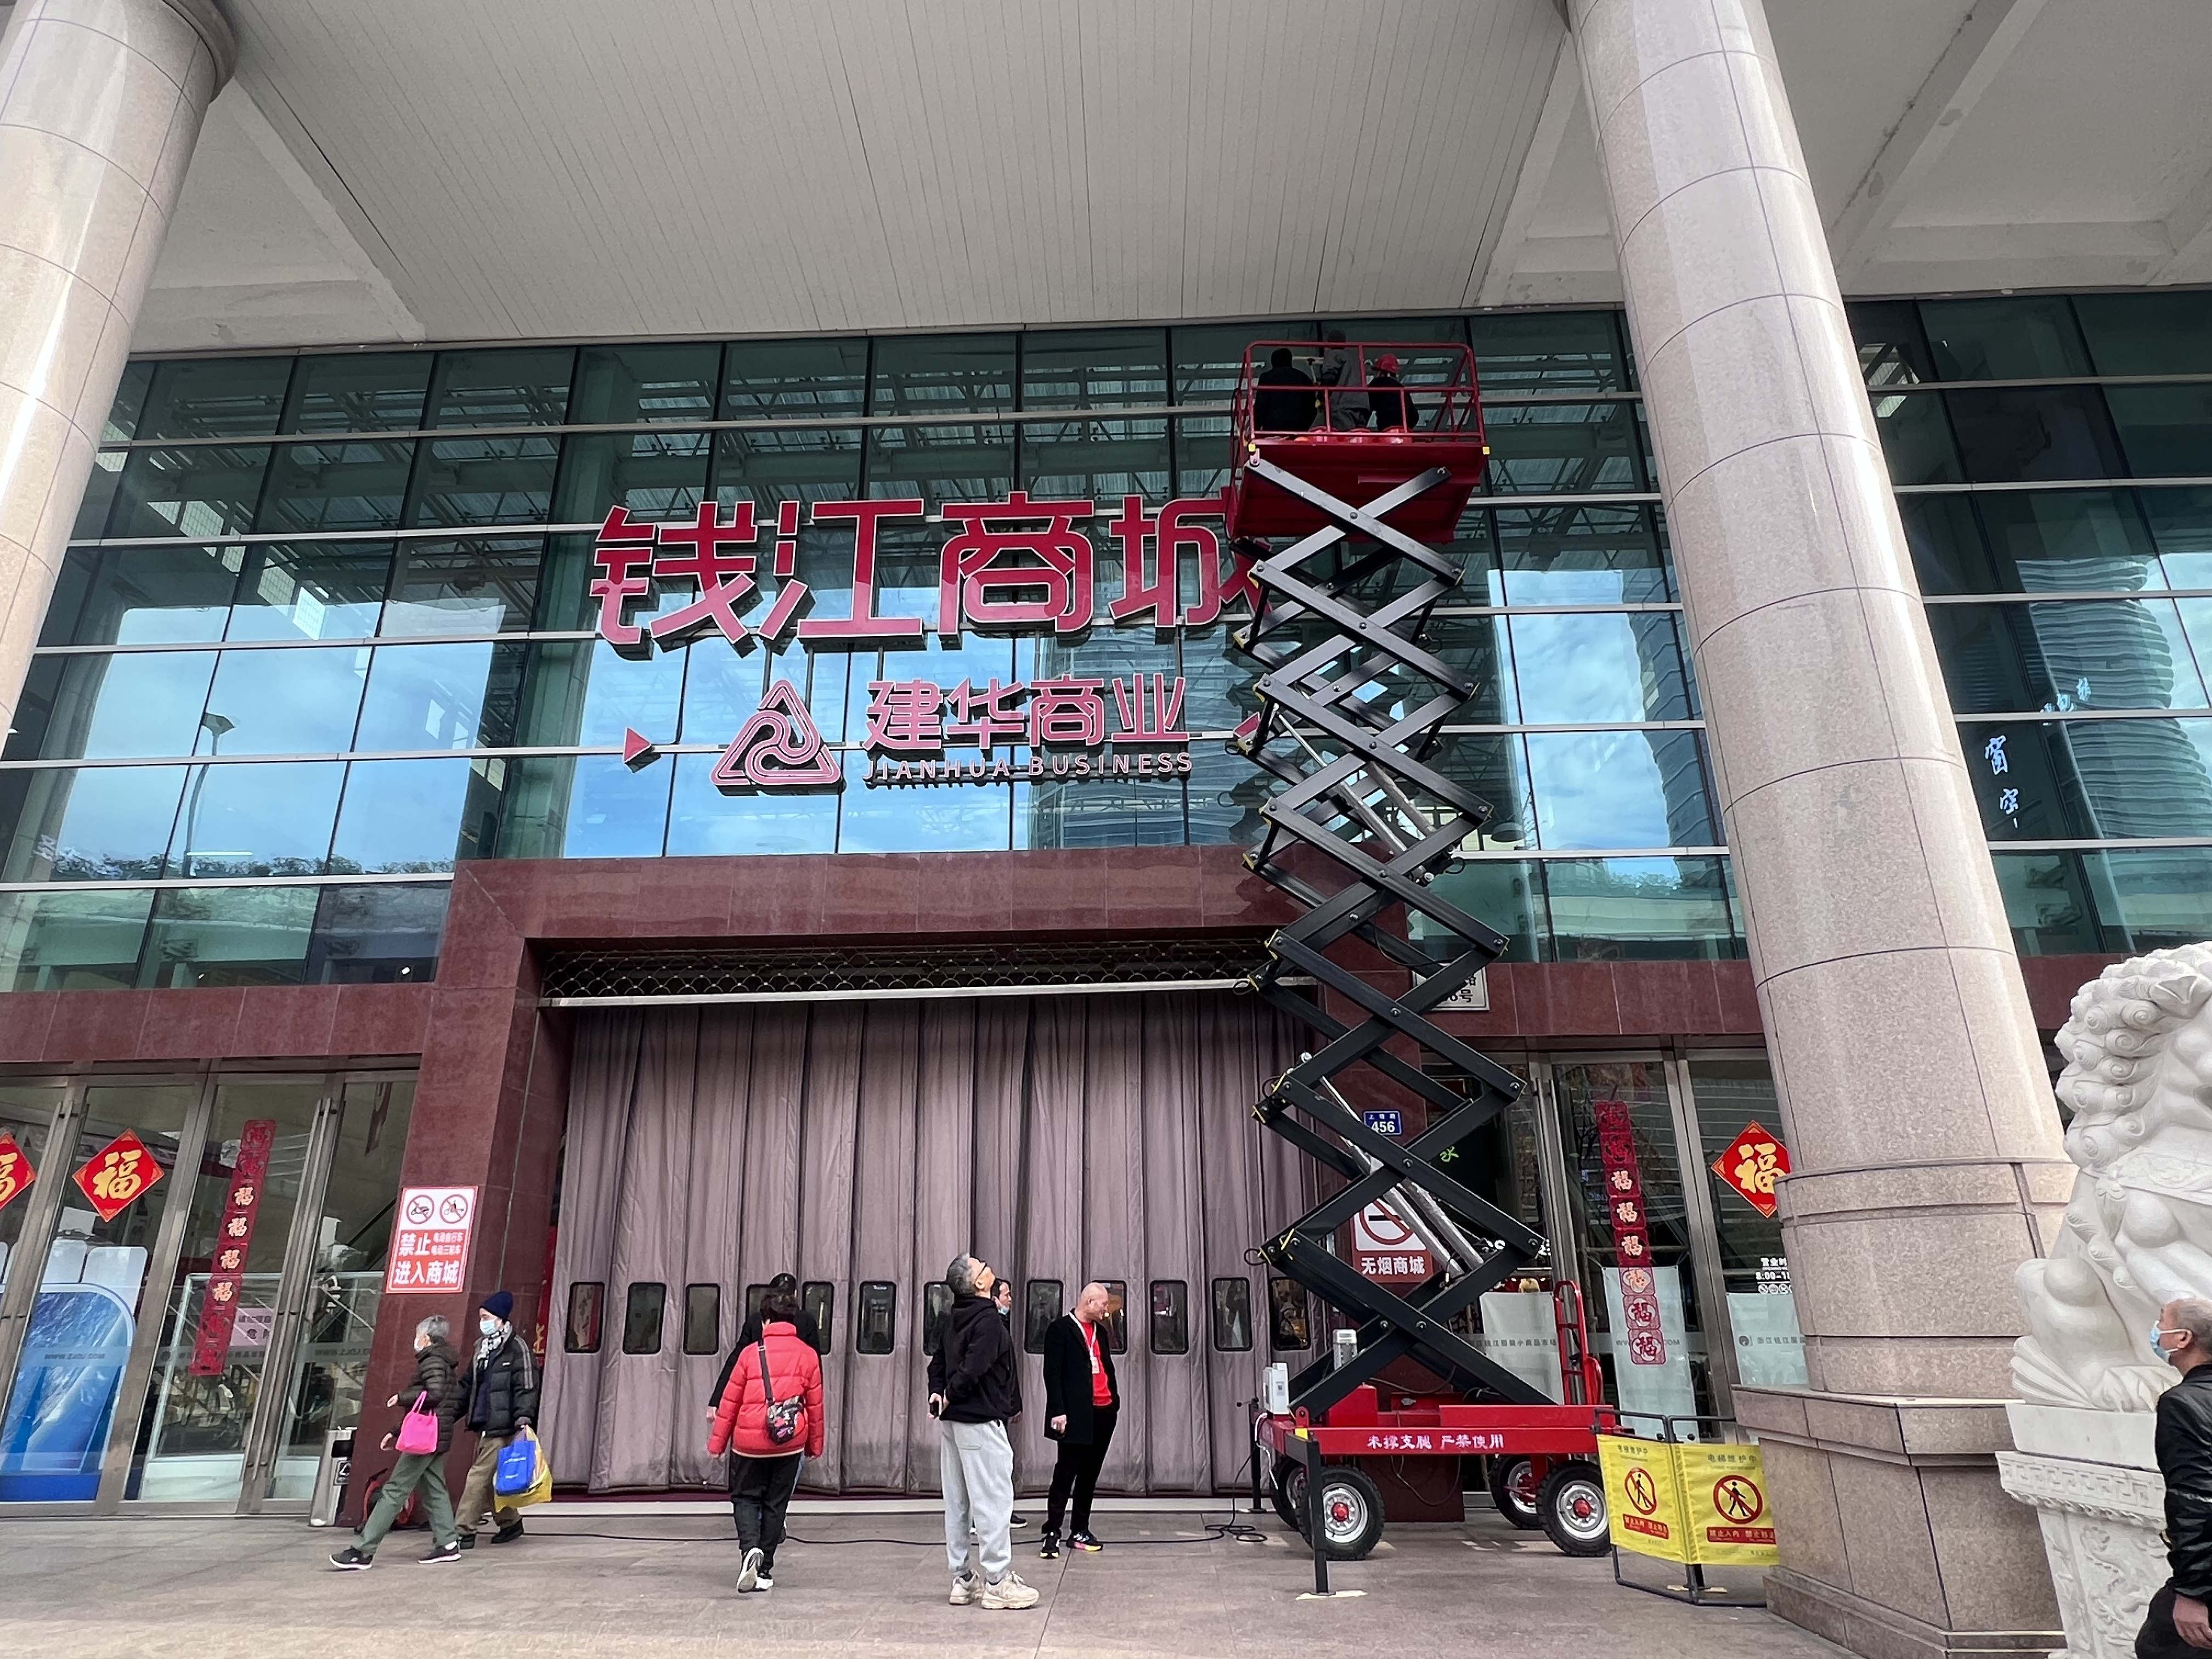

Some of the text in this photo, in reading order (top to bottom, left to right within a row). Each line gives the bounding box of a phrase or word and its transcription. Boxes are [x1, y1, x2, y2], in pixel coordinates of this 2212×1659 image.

[589, 491, 1272, 644] 钱江商城
[863, 673, 1189, 751] 建华商业
[863, 752, 1193, 780] JIANHUA BUSINESS
[1371, 1121, 1396, 1133] 456
[92, 1149, 142, 1199] 福
[1734, 1143, 1787, 1194] 福
[1611, 1170, 1633, 1191] 福
[234, 1187, 254, 1206] 福
[1616, 1201, 1638, 1222] 福
[227, 1217, 247, 1237] 福
[398, 1232, 431, 1256] 禁止
[1622, 1235, 1643, 1256] 福
[221, 1250, 240, 1269] 福
[1361, 1256, 1425, 1276] 无烟商城
[393, 1260, 460, 1285] 进入商城
[213, 1282, 233, 1302] 福
[1632, 1302, 1652, 1322] 福
[1636, 1336, 1657, 1356] 福
[1367, 1434, 1504, 1450] 未撑支腿 严禁使用
